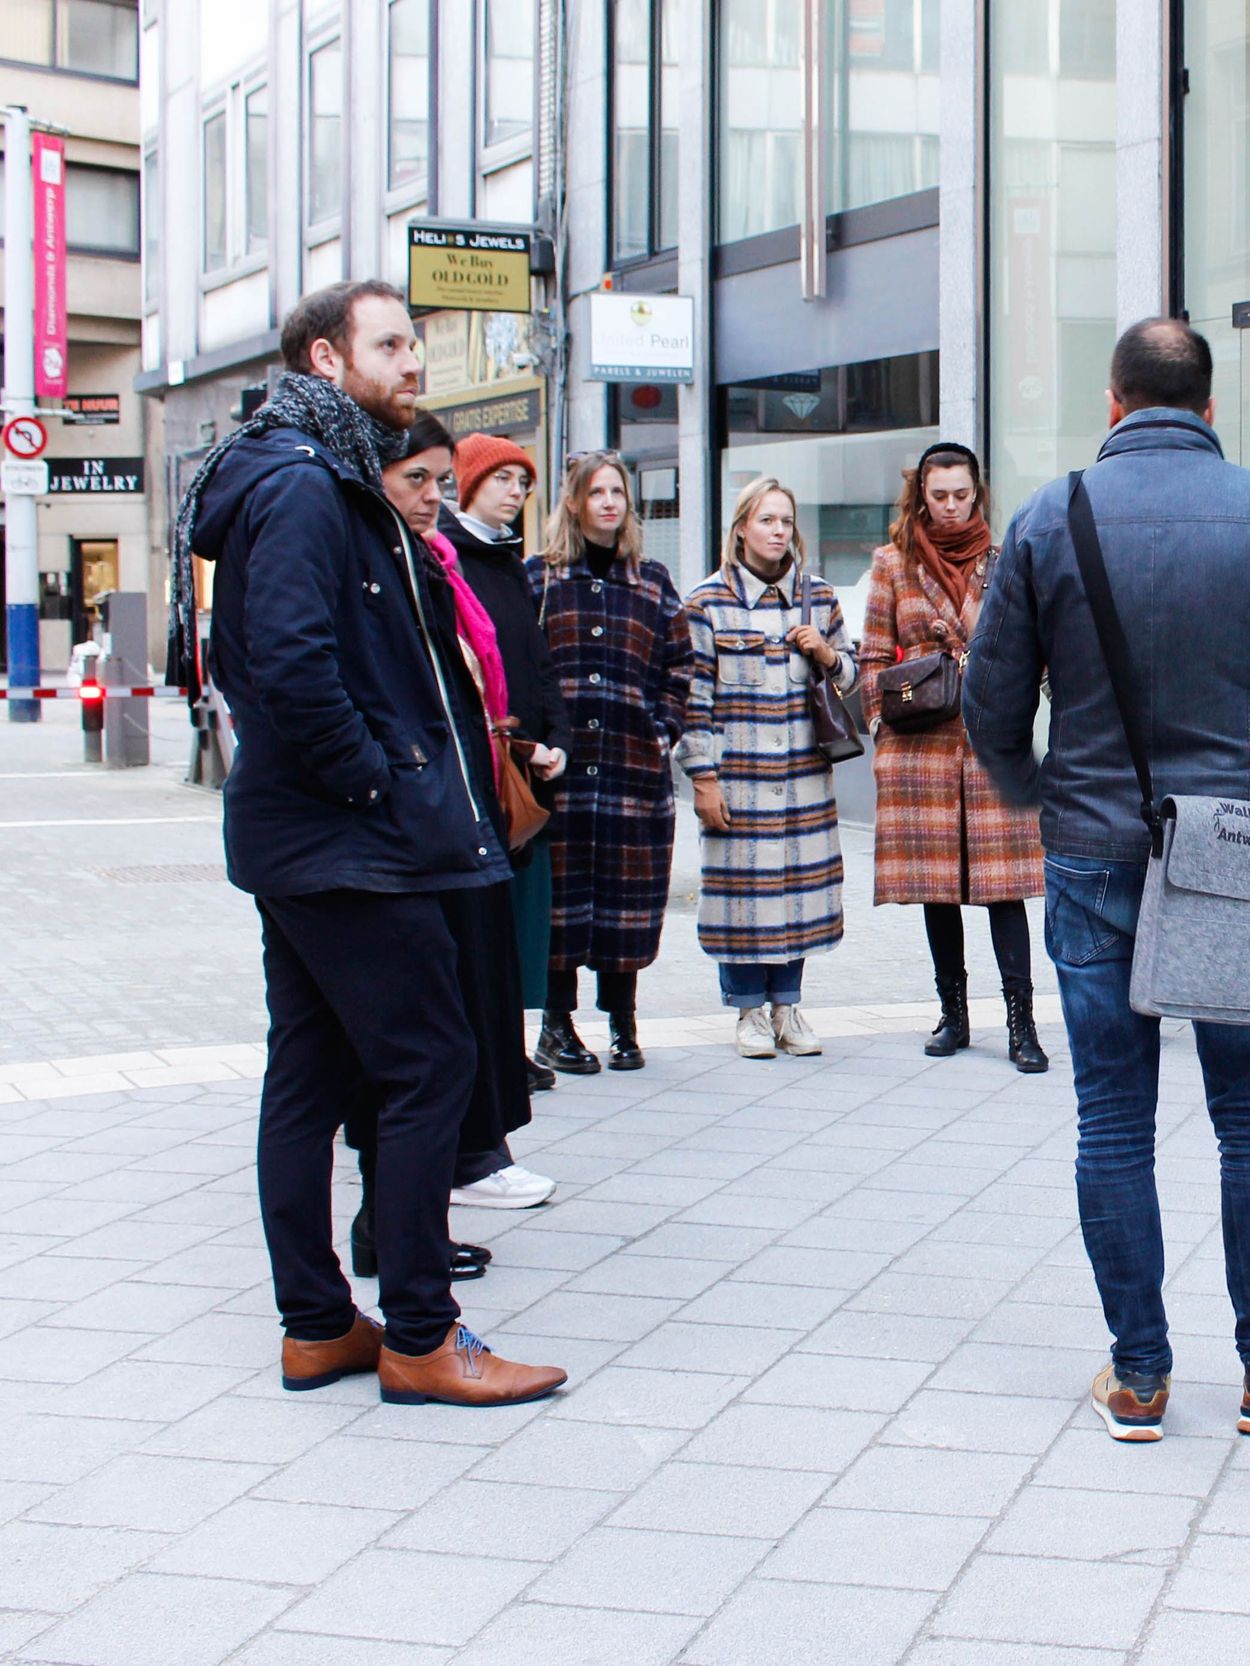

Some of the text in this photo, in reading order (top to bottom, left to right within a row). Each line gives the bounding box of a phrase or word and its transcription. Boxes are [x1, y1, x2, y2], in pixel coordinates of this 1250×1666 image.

[468, 233, 525, 250] JEWELS
[446, 253, 468, 268] We
[432, 270, 509, 287] OLD GOLD
[650, 333, 689, 350] Pearl
[481, 398, 529, 429] EXPERTISE
[83, 460, 105, 475] IN
[49, 475, 138, 491] JEWELRY
